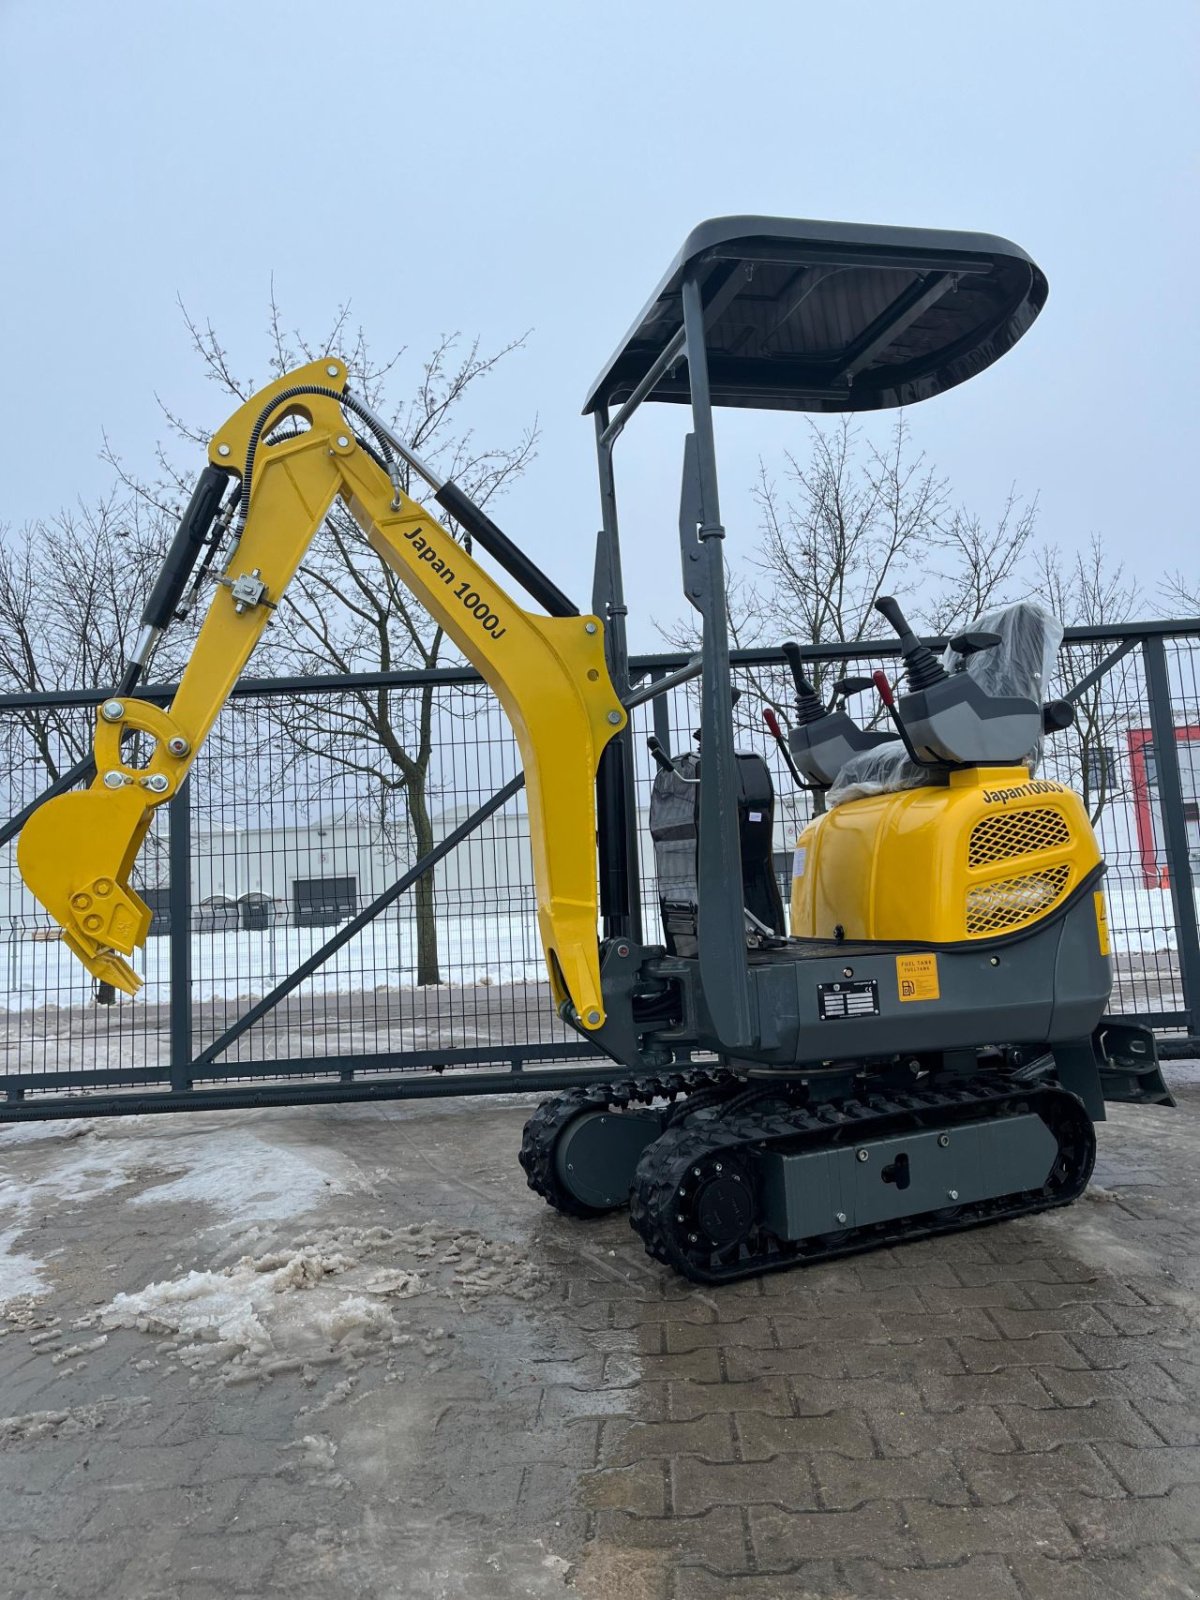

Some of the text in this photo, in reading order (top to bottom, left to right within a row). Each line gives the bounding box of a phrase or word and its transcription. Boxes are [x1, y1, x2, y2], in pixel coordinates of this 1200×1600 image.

[403, 527, 507, 640] Japan 1000J
[982, 780, 1064, 805] Japan1000J
